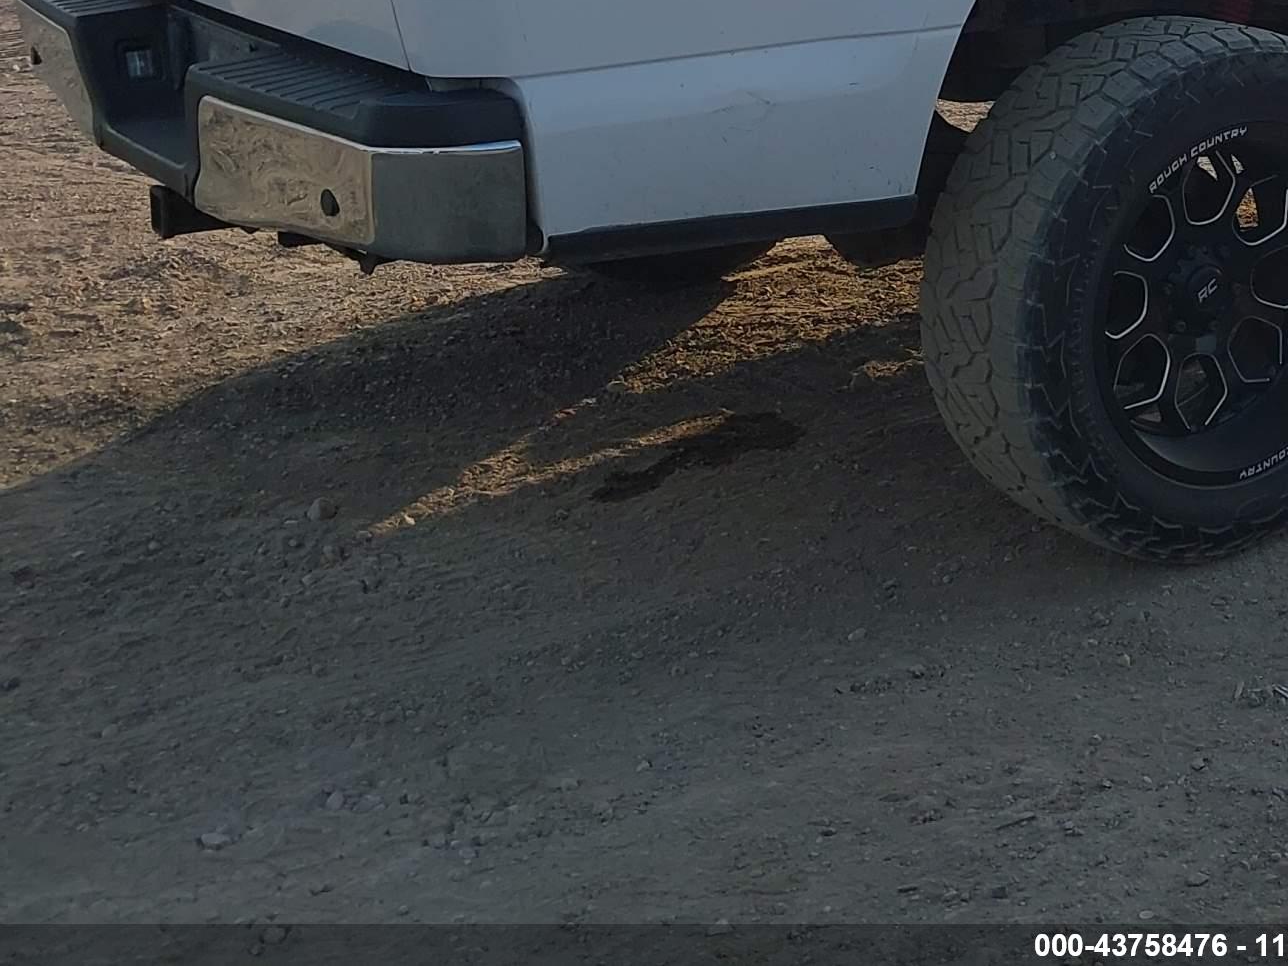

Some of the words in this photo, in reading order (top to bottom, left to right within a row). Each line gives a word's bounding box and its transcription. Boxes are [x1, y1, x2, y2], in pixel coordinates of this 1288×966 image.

[1148, 153, 1188, 194] ROUGH
[1190, 126, 1248, 158] COUNTRY
[1197, 278, 1218, 303] RC
